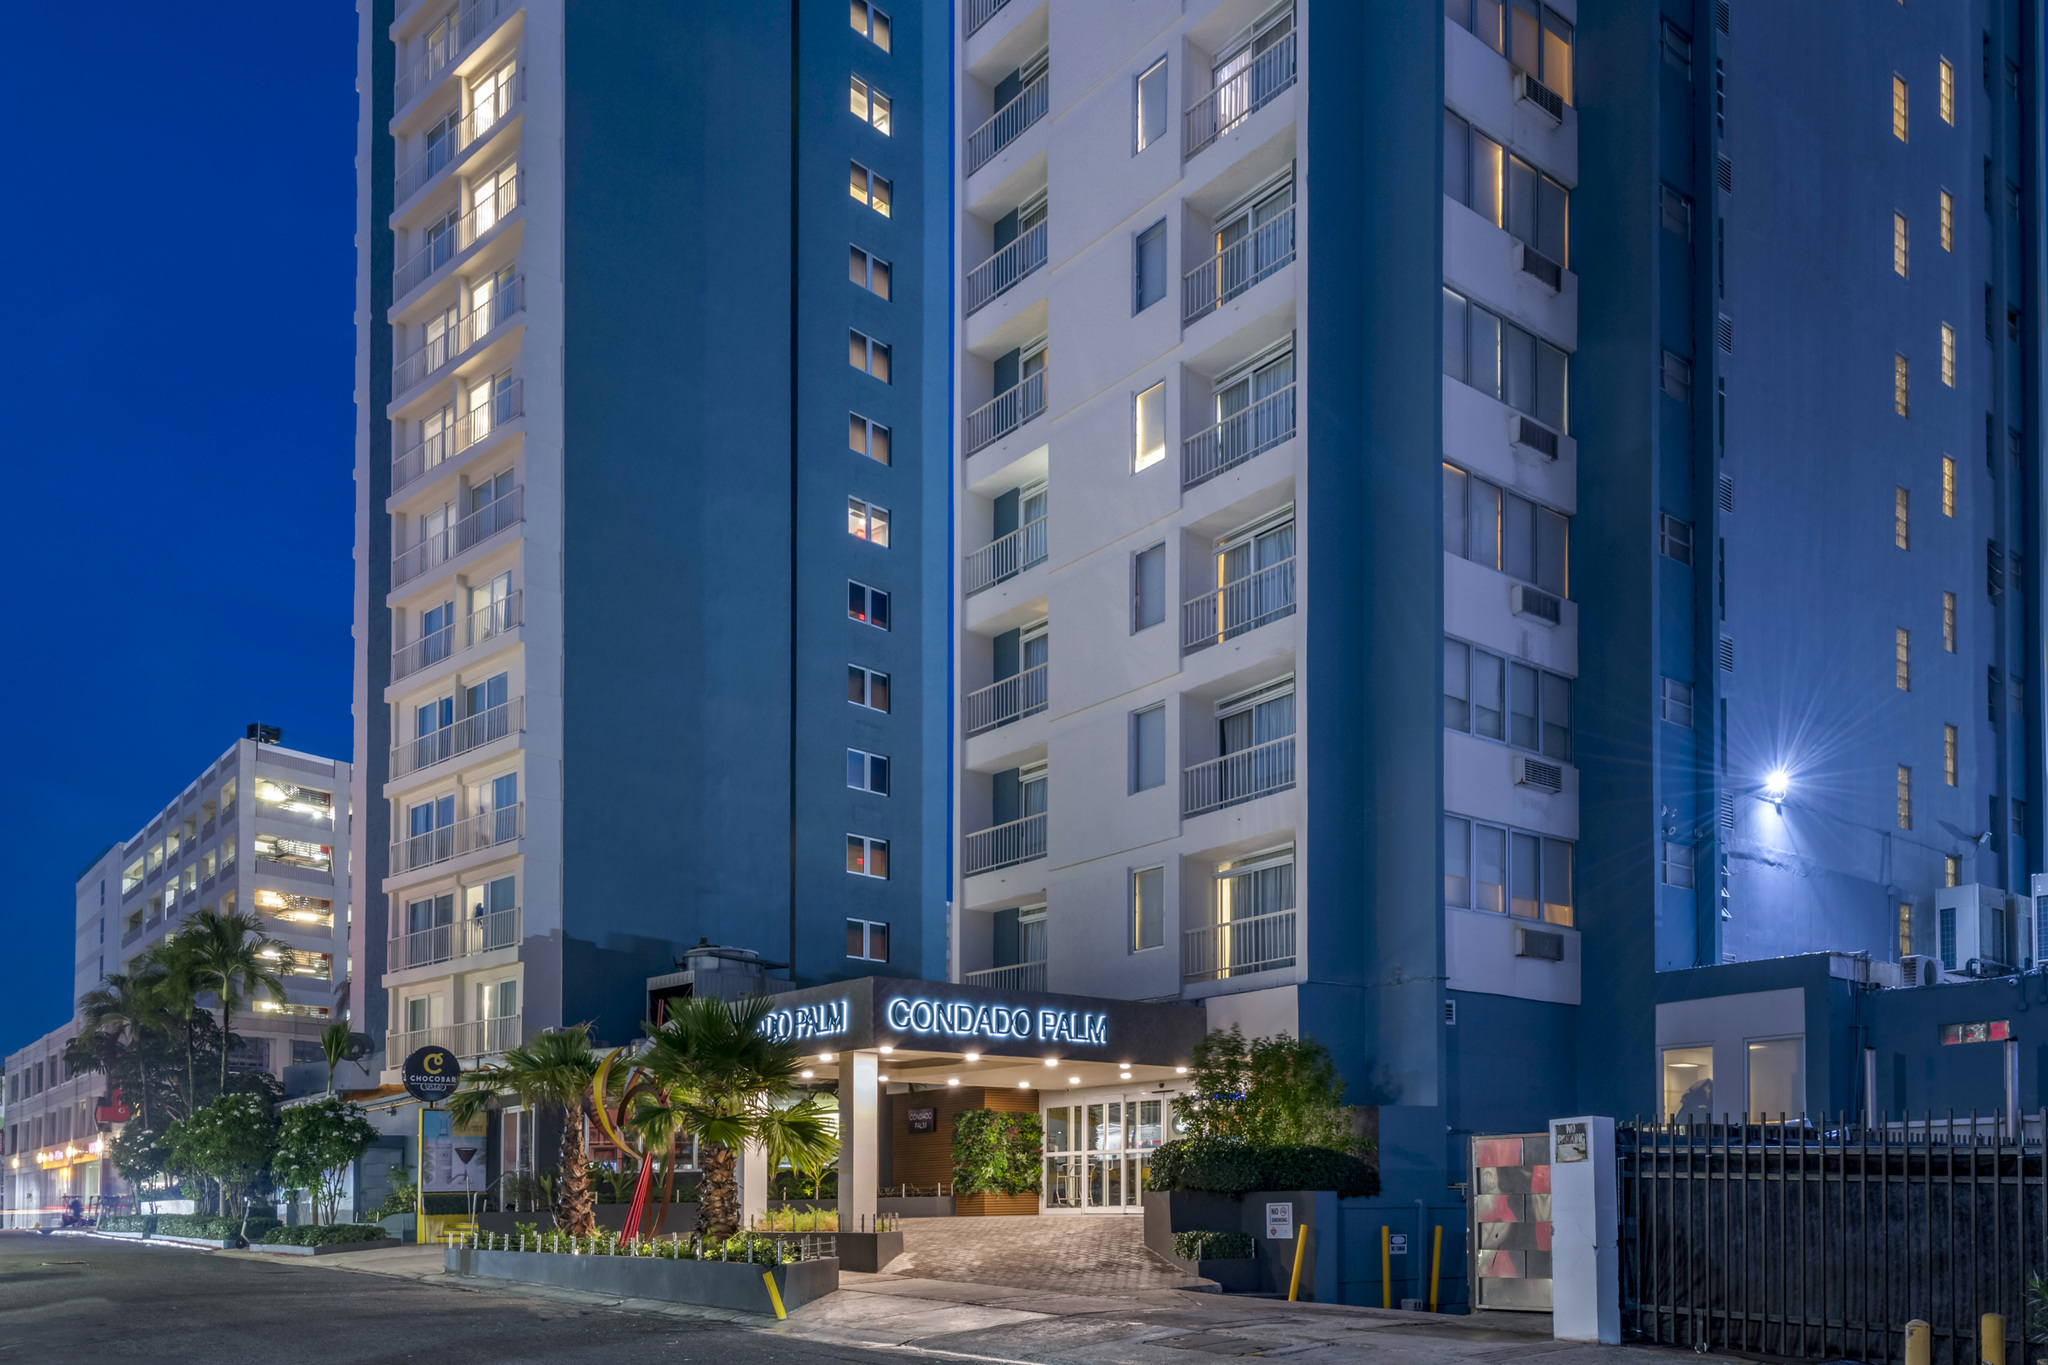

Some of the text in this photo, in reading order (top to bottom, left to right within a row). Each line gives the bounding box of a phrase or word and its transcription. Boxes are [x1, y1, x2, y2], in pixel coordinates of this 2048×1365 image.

[794, 1001, 847, 1038] PALM
[888, 998, 1108, 1043] CONDADO PALM
[410, 1075, 457, 1083] CHOCOBAR
[909, 1112, 933, 1121] CONDADO
[1565, 1124, 1576, 1134] NO
[1271, 1208, 1279, 1216] NO
